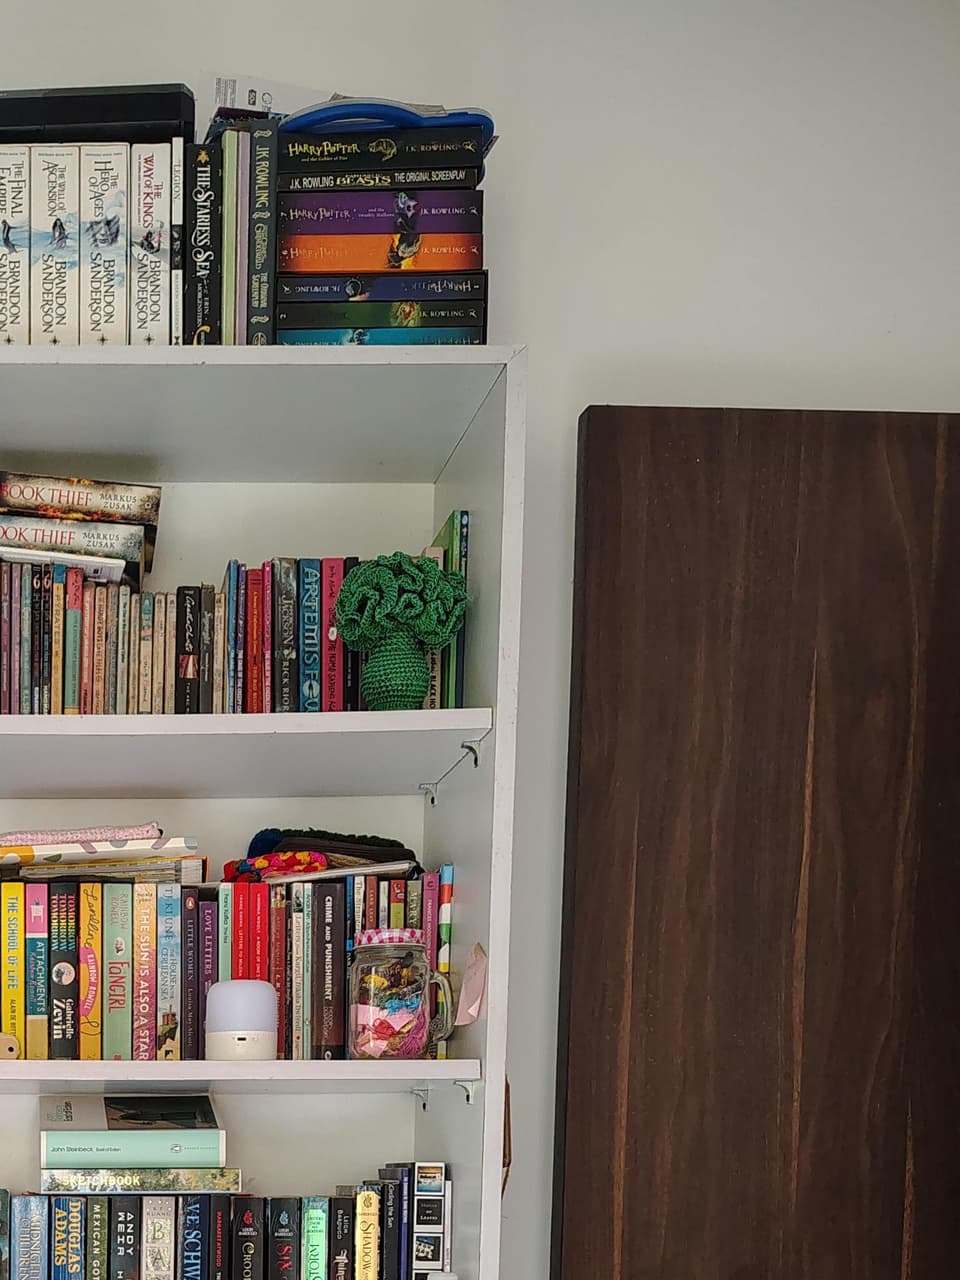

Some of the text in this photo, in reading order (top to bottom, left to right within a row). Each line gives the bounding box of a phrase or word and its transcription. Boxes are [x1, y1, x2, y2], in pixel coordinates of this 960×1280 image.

[197, 165, 211, 188] THE
[289, 141, 360, 157] HARRY POTTER
[394, 170, 466, 182] THE ORIGINAL SCREENPLAY
[11, 161, 26, 218] THE FINAL
[42, 160, 58, 217] ASCENSION
[290, 176, 334, 189] J.K. ROWLING
[192, 247, 214, 277] SEA
[8, 260, 21, 325] BRANDON
[1, 483, 93, 507] BOOK THIEF
[99, 493, 137, 504] MARKUS
[103, 501, 132, 512] ZUSAK
[303, 567, 320, 668] ARTEMIS
[51, 894, 59, 952] TOMORROW
[59, 893, 67, 951] TOMORROW
[83, 888, 100, 948] Landline
[325, 896, 333, 923] CRIME
[7, 897, 19, 989] THE SCHOOL OF LIFE
[204, 910, 212, 975] LOVE LETTERS
[35, 941, 46, 1013] ATTACHMENTS
[138, 908, 150, 1061] THE SUN IS ALSO A STAR
[325, 943, 333, 1001] PUNISHMENT
[53, 999, 63, 1040] Zevin
[62, 1175, 140, 1186] SKETCHBOOK
[55, 1208, 67, 1266] ADAMS
[68, 1201, 81, 1274] DOUGLAS
[117, 1212, 125, 1256] WEIR
[126, 1212, 134, 1256] ANDY
